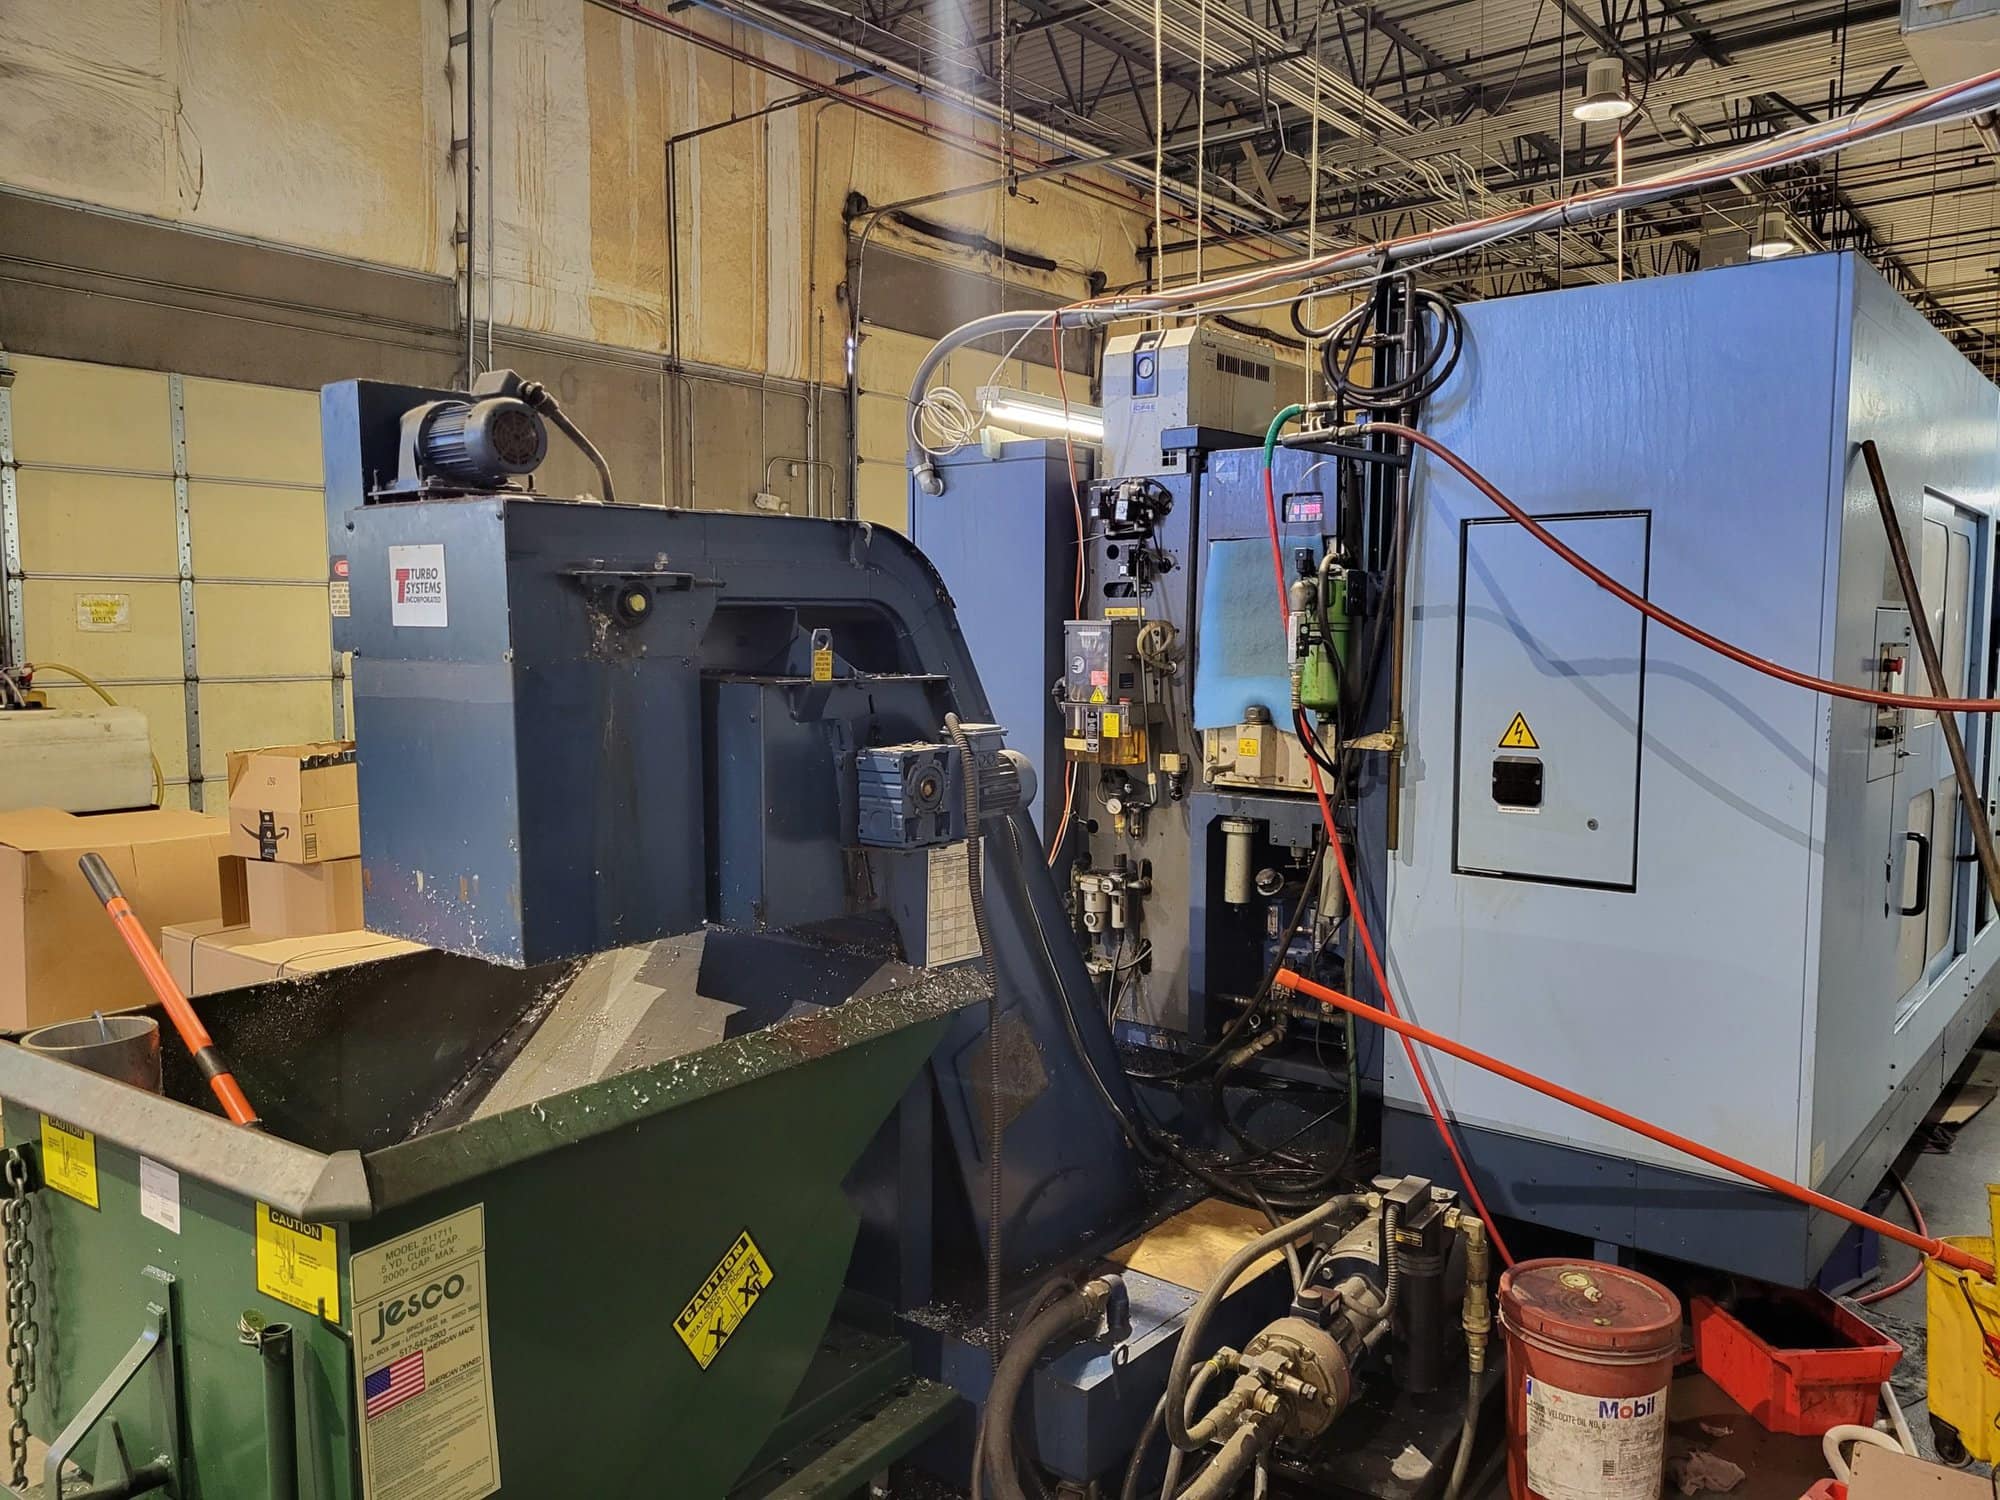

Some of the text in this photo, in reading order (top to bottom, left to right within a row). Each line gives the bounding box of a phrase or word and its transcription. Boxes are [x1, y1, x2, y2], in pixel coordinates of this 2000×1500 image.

[411, 568, 438, 580] TURBO
[406, 582, 442, 594] SYSTEMS
[406, 596, 441, 604] INCORPORATED
[50, 1116, 83, 1137] CAUTION
[271, 1211, 320, 1239] CAUTION
[381, 1266, 388, 1275] 5
[407, 1243, 436, 1261] CUBIC
[385, 1241, 419, 1261] MODEL
[684, 1243, 744, 1323] CAUTION
[371, 1274, 465, 1345] jesco
[688, 1318, 703, 1338] STAY
[426, 1333, 457, 1353] AMERICAN
[428, 1356, 482, 1386] AMERICAN OWNED
[1548, 1408, 1576, 1425] VELOCITE
[1576, 1417, 1587, 1427] OIL
[1599, 1396, 1656, 1420] Mobil
